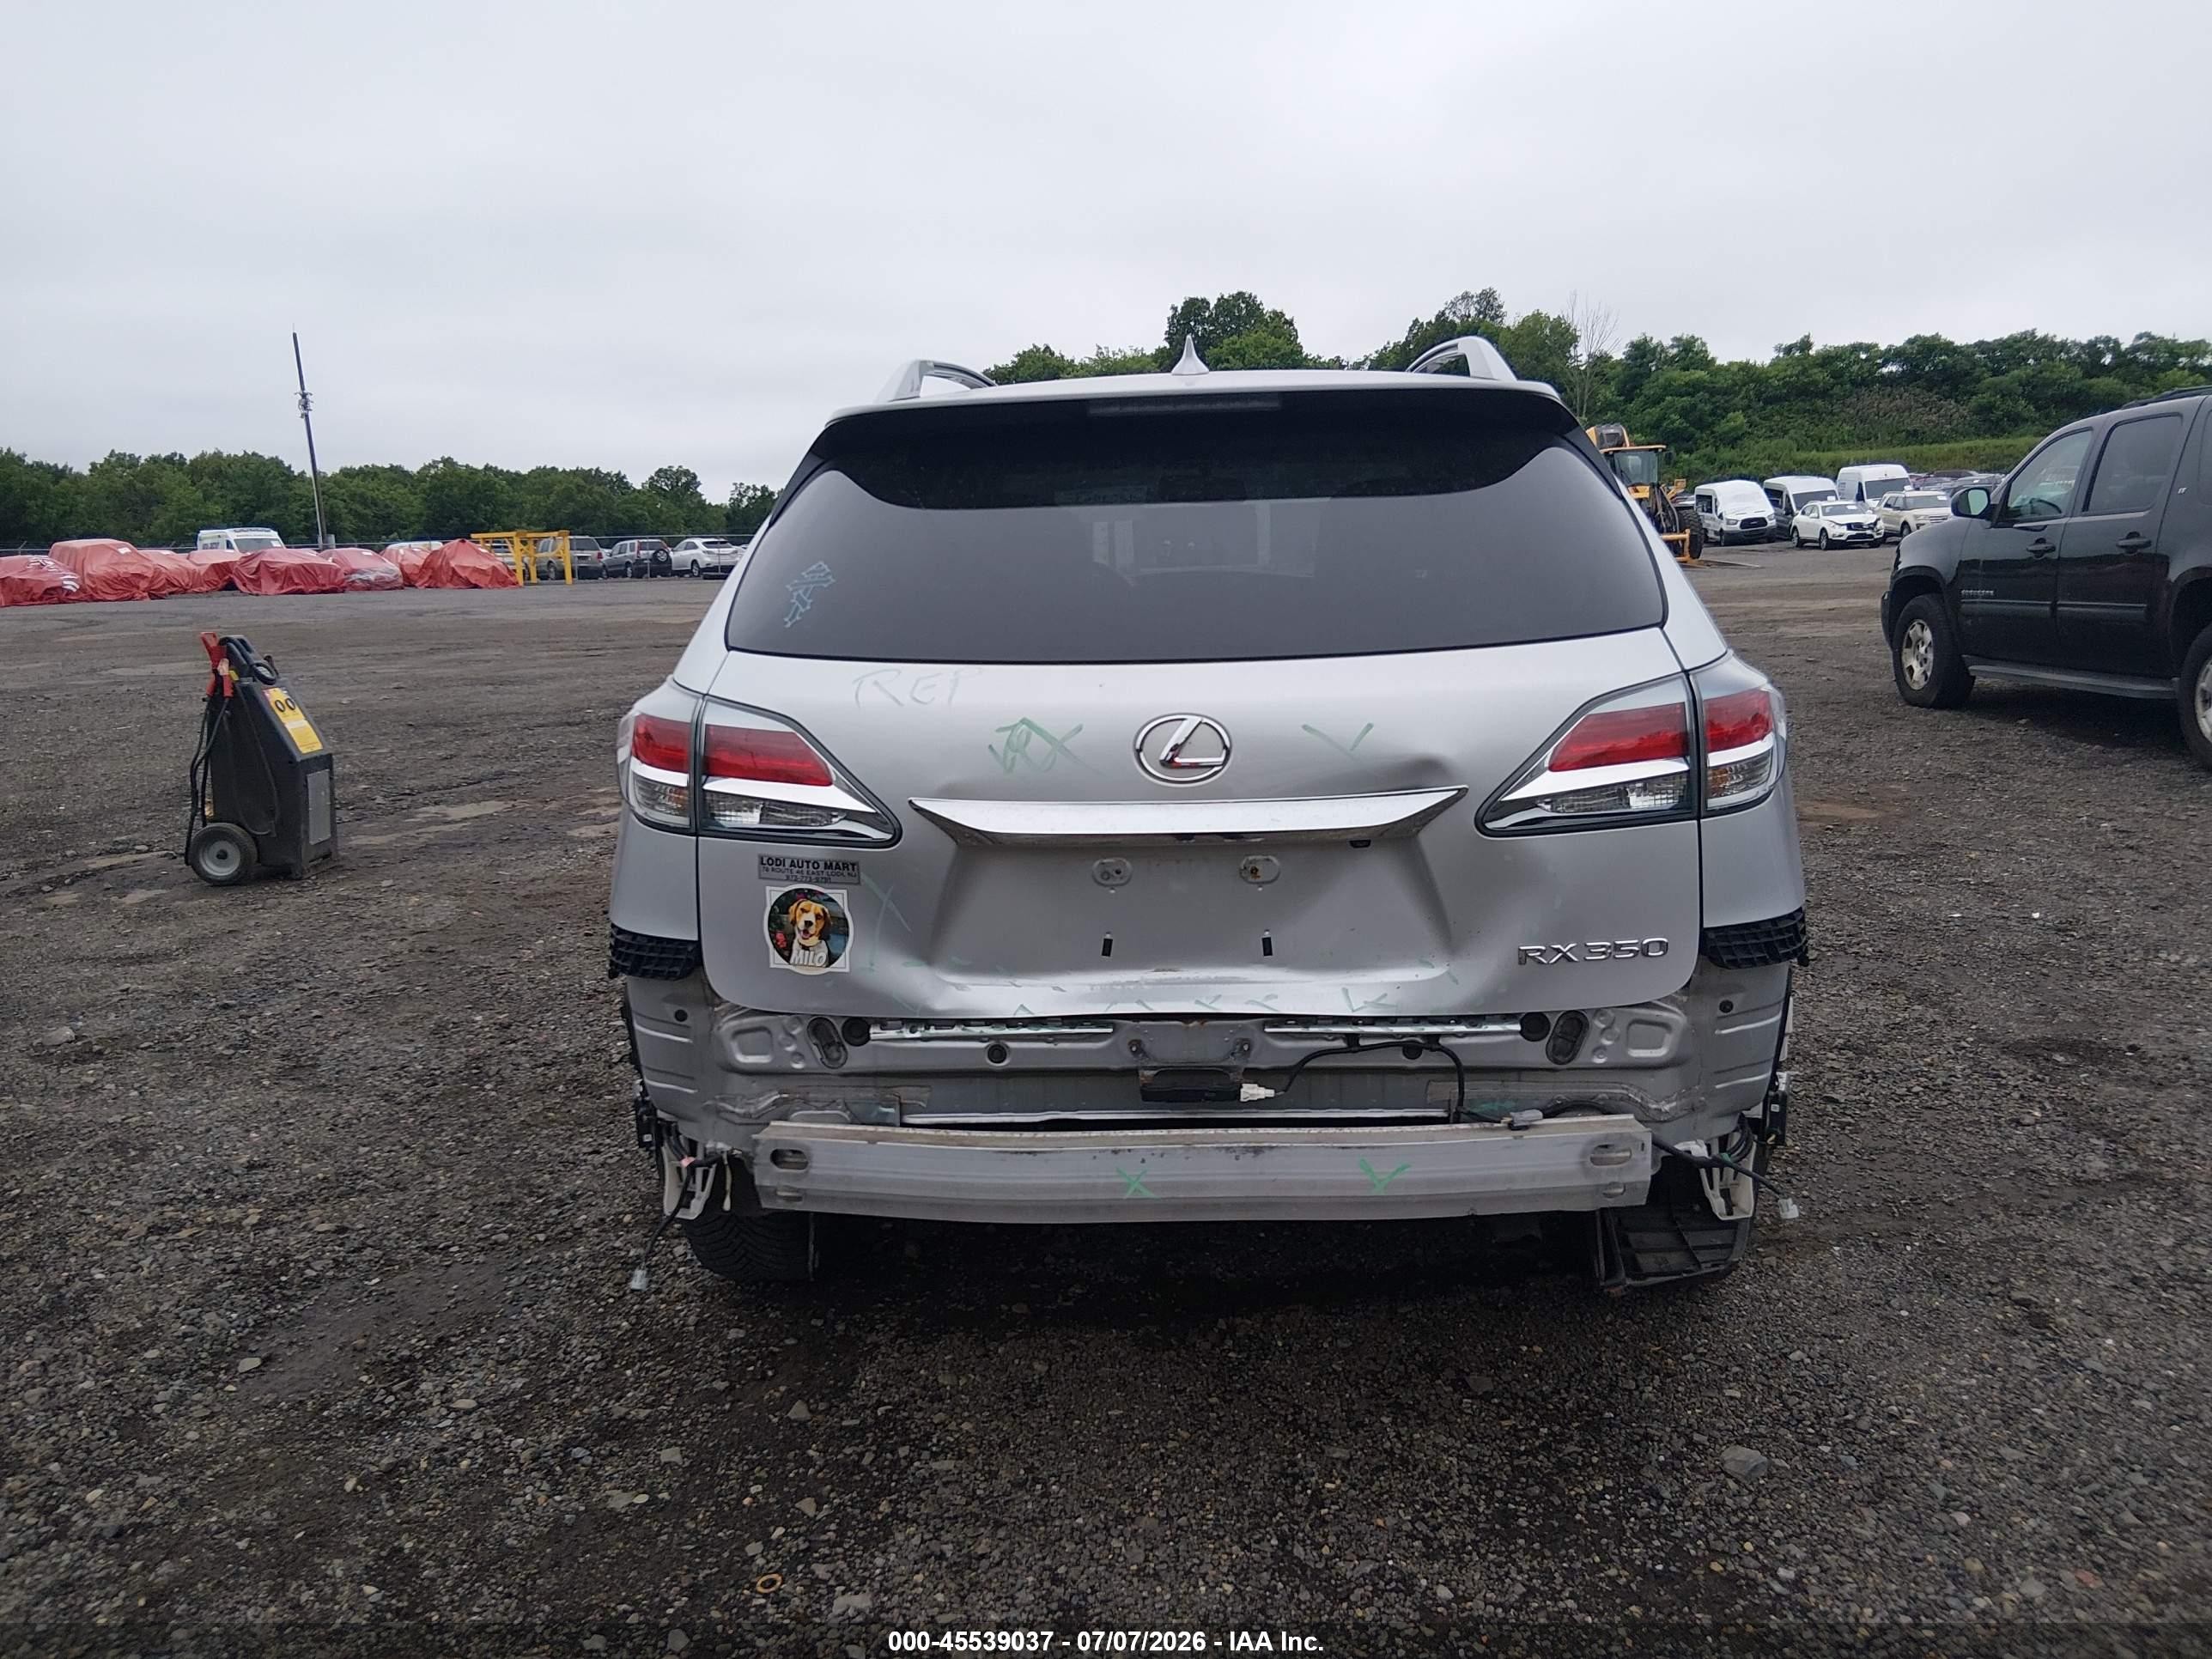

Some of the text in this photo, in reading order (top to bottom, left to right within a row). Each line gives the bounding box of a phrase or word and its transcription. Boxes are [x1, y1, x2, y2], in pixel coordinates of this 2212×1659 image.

[760, 856, 857, 872] LODI AUTO MART
[790, 948, 827, 967] MILO
